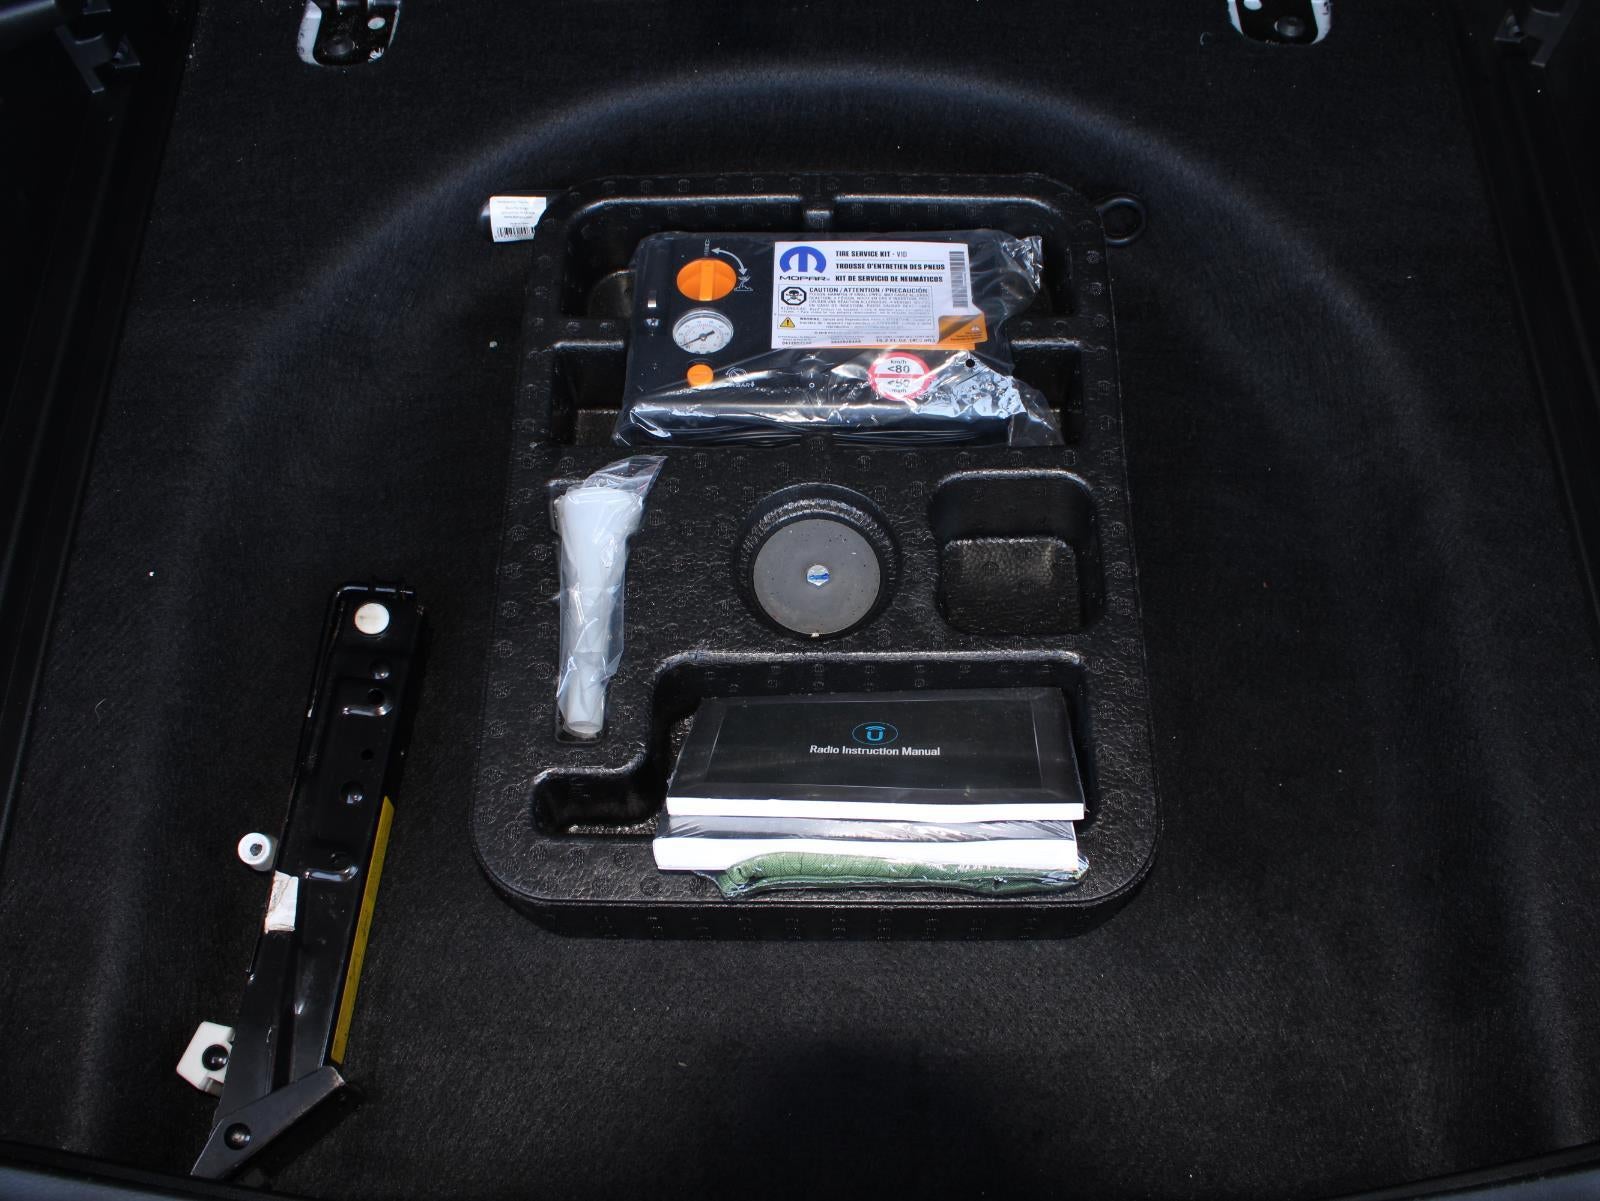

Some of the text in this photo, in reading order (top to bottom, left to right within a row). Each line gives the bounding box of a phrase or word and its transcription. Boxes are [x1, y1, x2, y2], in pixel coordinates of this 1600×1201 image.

[809, 744, 941, 757] Radio Instruction Manual
